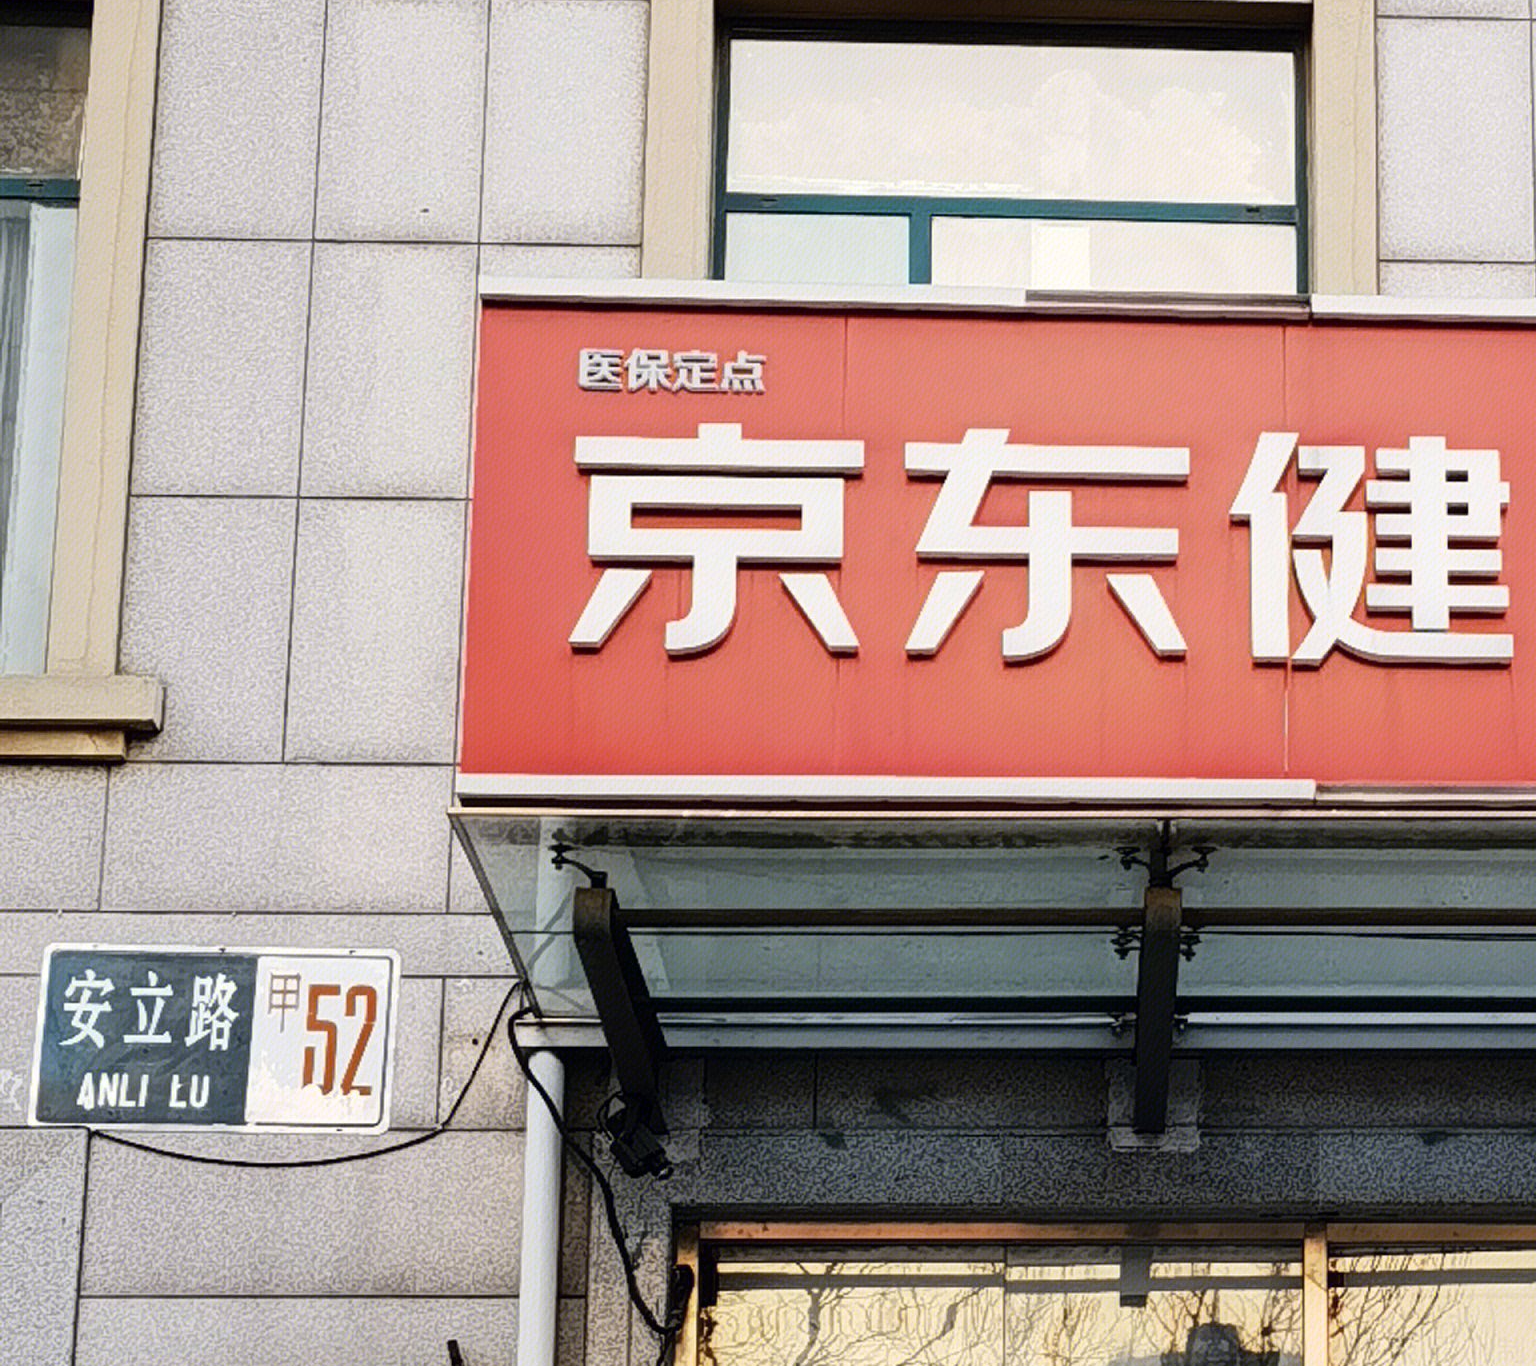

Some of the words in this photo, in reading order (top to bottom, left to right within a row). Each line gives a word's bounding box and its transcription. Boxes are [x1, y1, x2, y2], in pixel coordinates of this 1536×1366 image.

[578, 348, 767, 394] 医保定点
[59, 968, 239, 1051] 安立路
[303, 983, 378, 1096] 52
[77, 1072, 149, 1109] ANLI
[169, 1074, 210, 1108] LU
